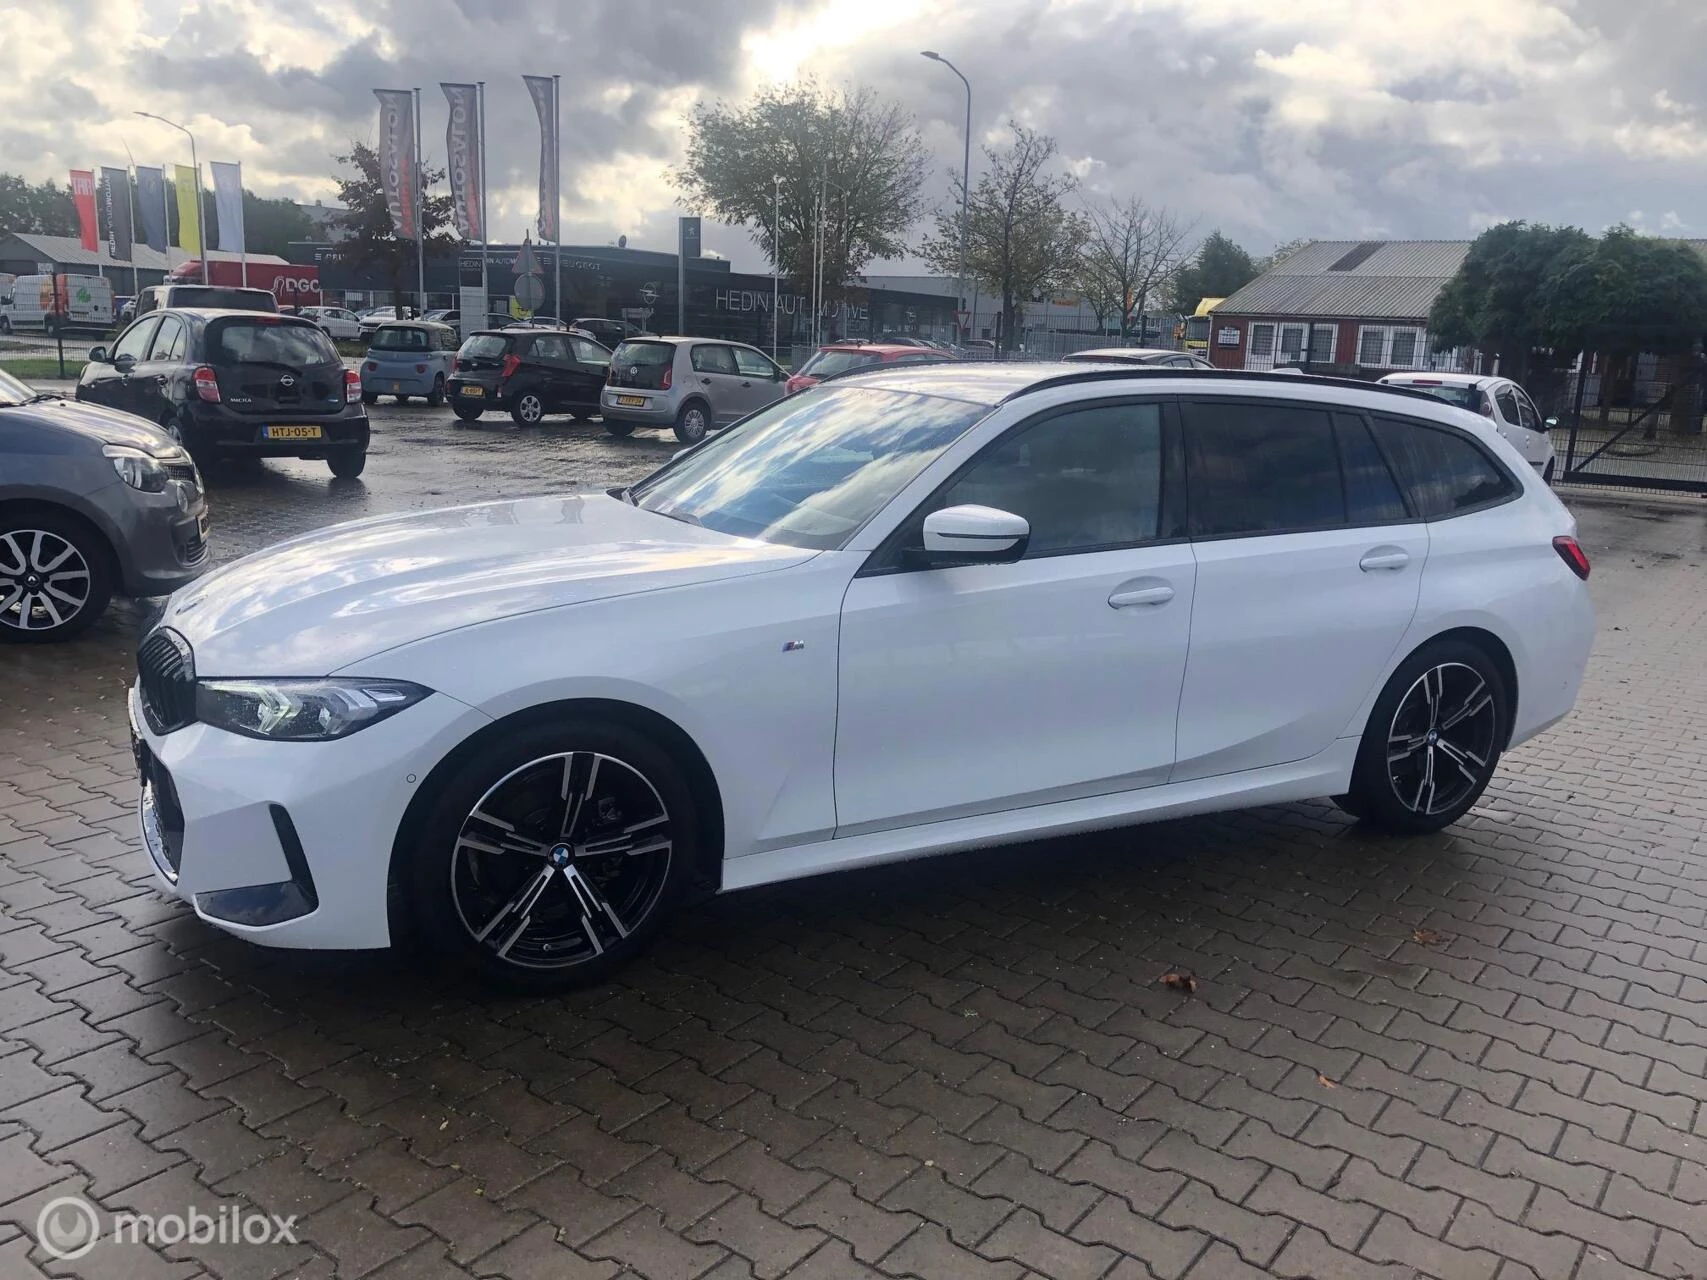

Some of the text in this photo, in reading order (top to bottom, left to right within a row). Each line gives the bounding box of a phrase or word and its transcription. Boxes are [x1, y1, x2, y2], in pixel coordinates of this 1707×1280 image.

[715, 288, 869, 319] HEDIN AUTMIVE
[271, 427, 317, 437] HTJ-05-T
